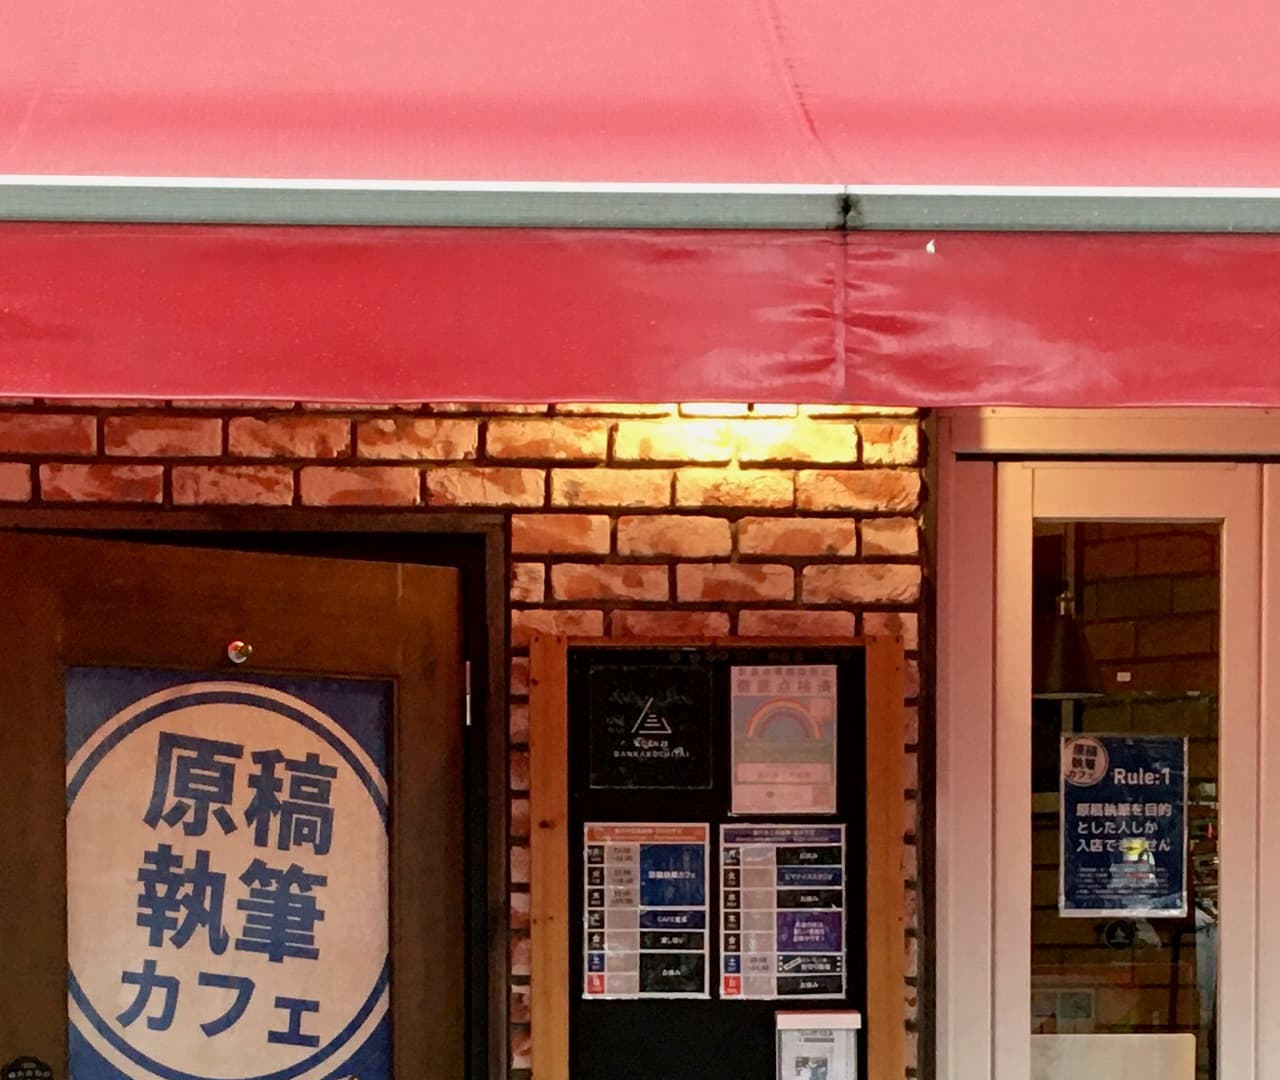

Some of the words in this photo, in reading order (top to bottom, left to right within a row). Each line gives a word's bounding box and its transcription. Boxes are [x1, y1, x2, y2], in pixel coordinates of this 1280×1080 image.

[142, 731, 338, 856] 原稿
[1114, 768, 1170, 785] Rule:1
[1076, 803, 1172, 817] 原稿執筆を目的
[1076, 821, 1159, 834] とした人しか
[136, 843, 328, 963] 執筆
[116, 960, 320, 1048] カフェ
